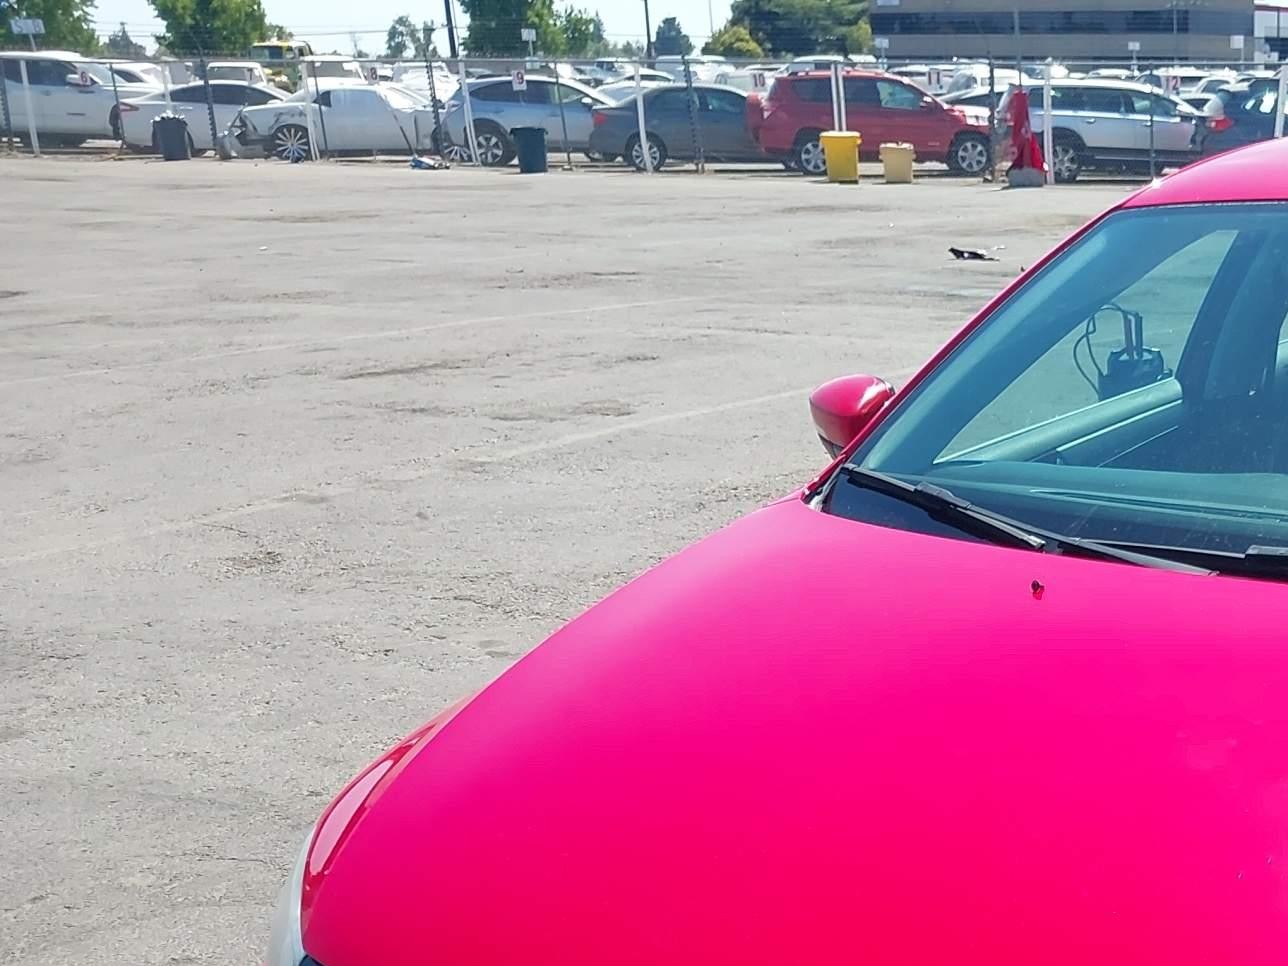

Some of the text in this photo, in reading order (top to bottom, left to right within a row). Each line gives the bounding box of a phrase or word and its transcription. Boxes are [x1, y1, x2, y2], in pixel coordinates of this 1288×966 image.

[80, 71, 88, 85] 6
[369, 68, 378, 81] 8
[516, 71, 525, 85] 9
[753, 73, 766, 88] 10
[927, 71, 941, 86] 11
[1165, 75, 1180, 91] 12
